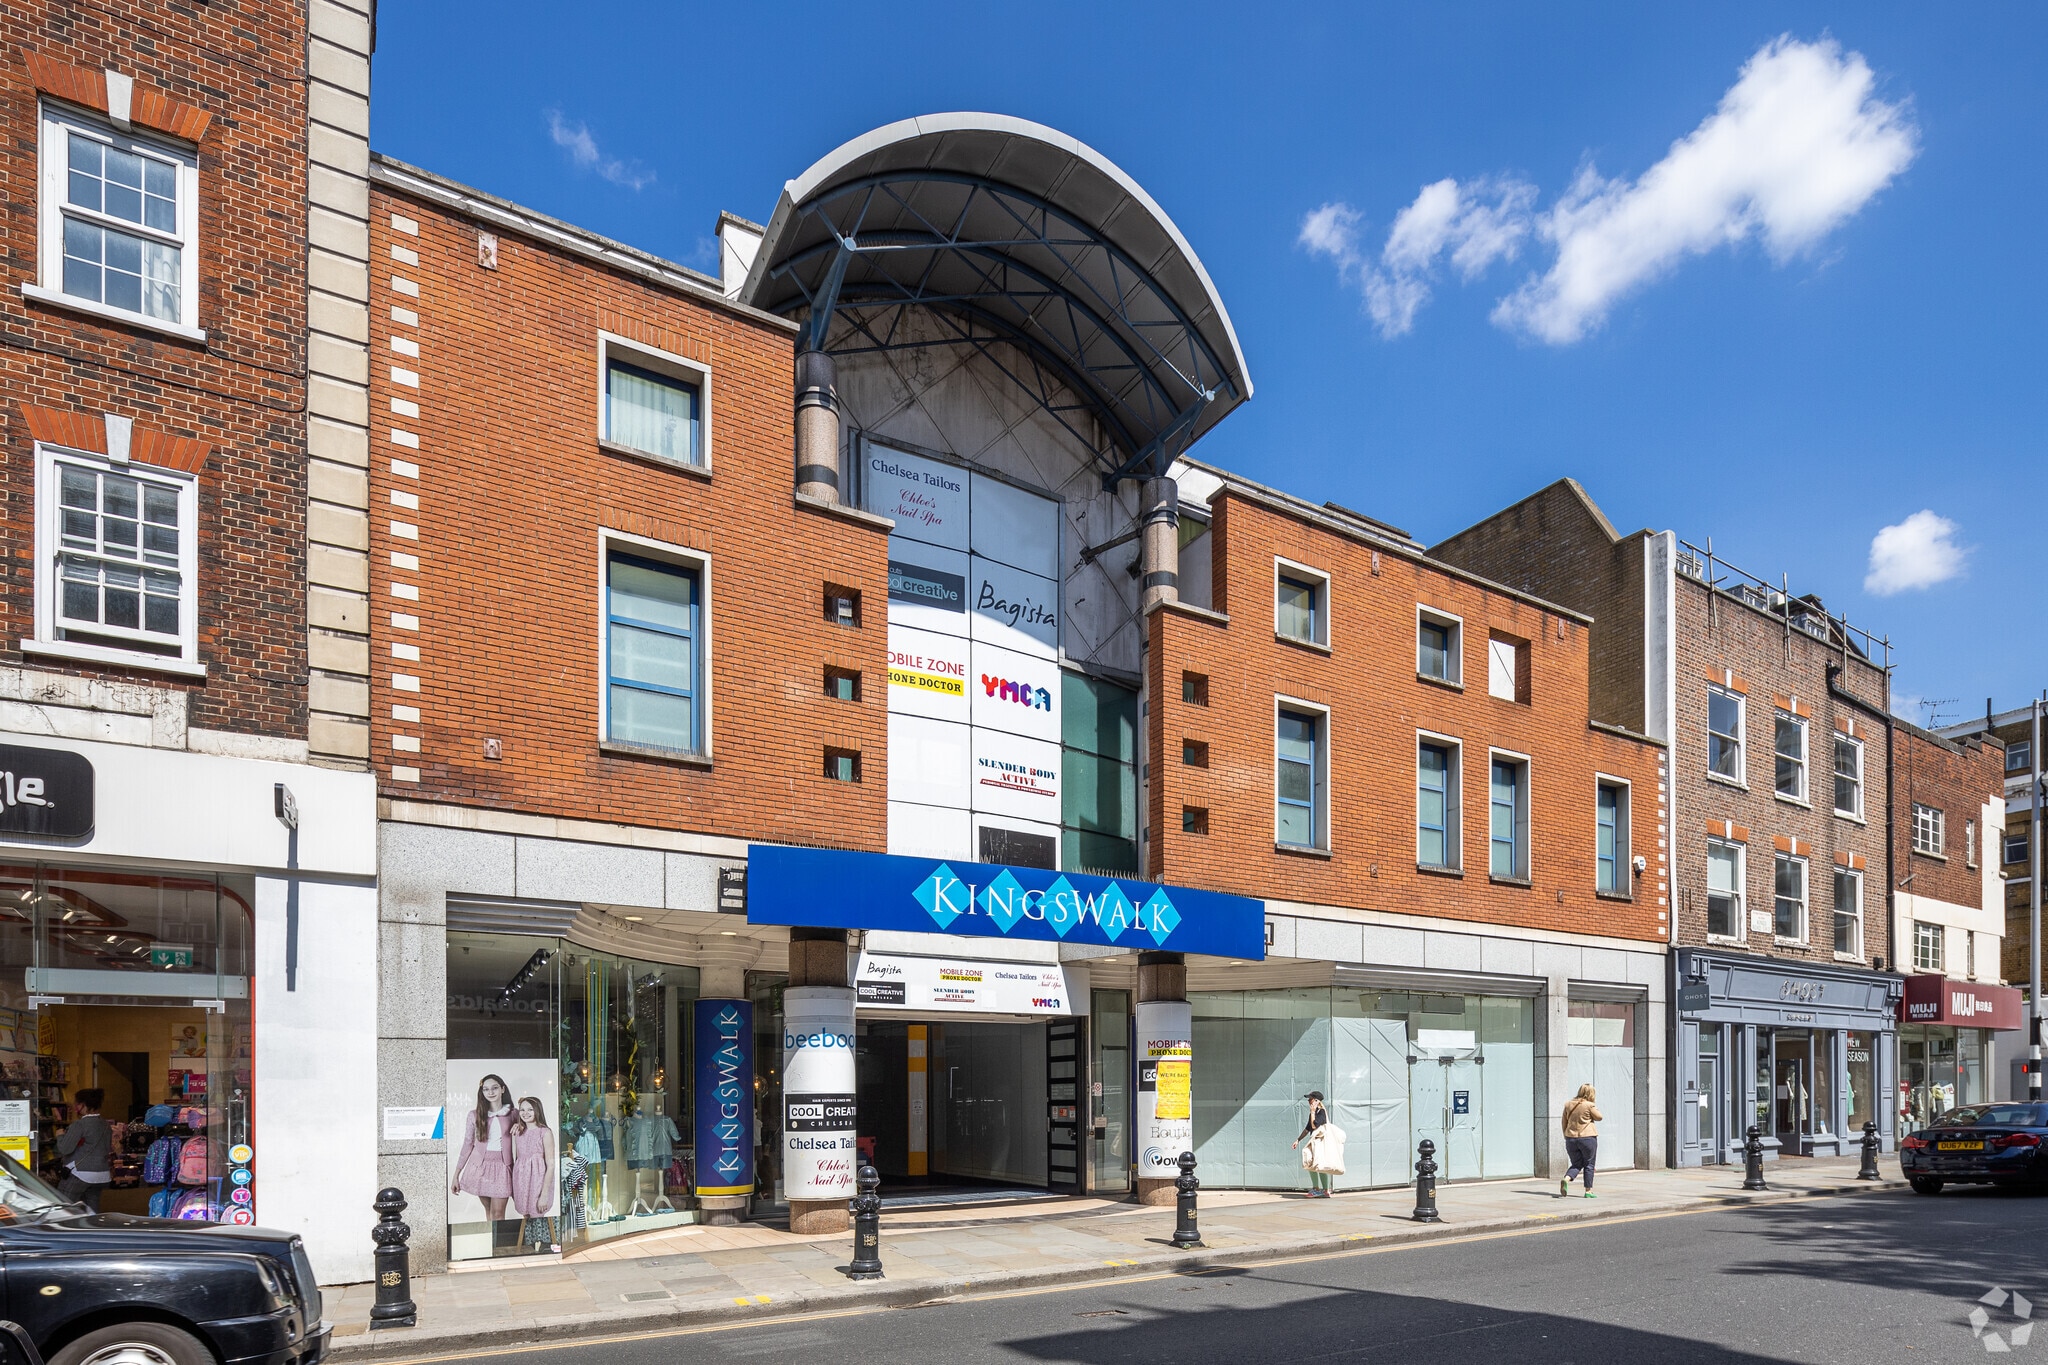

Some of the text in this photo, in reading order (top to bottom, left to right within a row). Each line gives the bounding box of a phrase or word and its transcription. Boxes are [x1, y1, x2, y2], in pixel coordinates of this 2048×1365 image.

[872, 459, 960, 492] Chelsea Tailors
[900, 489, 936, 508] Chloe's
[891, 504, 942, 526] Nail Spa
[903, 581, 958, 600] creative
[977, 580, 1057, 627] Bagista
[927, 659, 965, 676] ZONE
[919, 678, 961, 692] DOCTOR
[982, 673, 1051, 712] YMCA
[979, 758, 1056, 780] SLENDER BODY
[1000, 773, 1036, 787] ACTIVE
[932, 876, 1172, 933] KINGSWALK
[867, 962, 902, 978] Bagista
[940, 968, 963, 976] MOBILE
[995, 972, 1018, 980] Chelsea
[1032, 998, 1060, 1008] YMCA
[1910, 1003, 1937, 1014] MUJI
[1952, 992, 1975, 1017] MUJI
[1148, 1040, 1182, 1048] MOBILE
[1848, 1038, 1860, 1048] NEW
[1848, 1052, 1869, 1062] SEASON
[719, 1010, 738, 1173] KINGSWALK
[791, 1107, 821, 1117] COOL
[789, 1138, 836, 1149] Chelsea
[1964, 1141, 1979, 1149] VZF
[817, 1160, 850, 1171] Chloe's
[807, 1173, 853, 1188] Nail Spa
